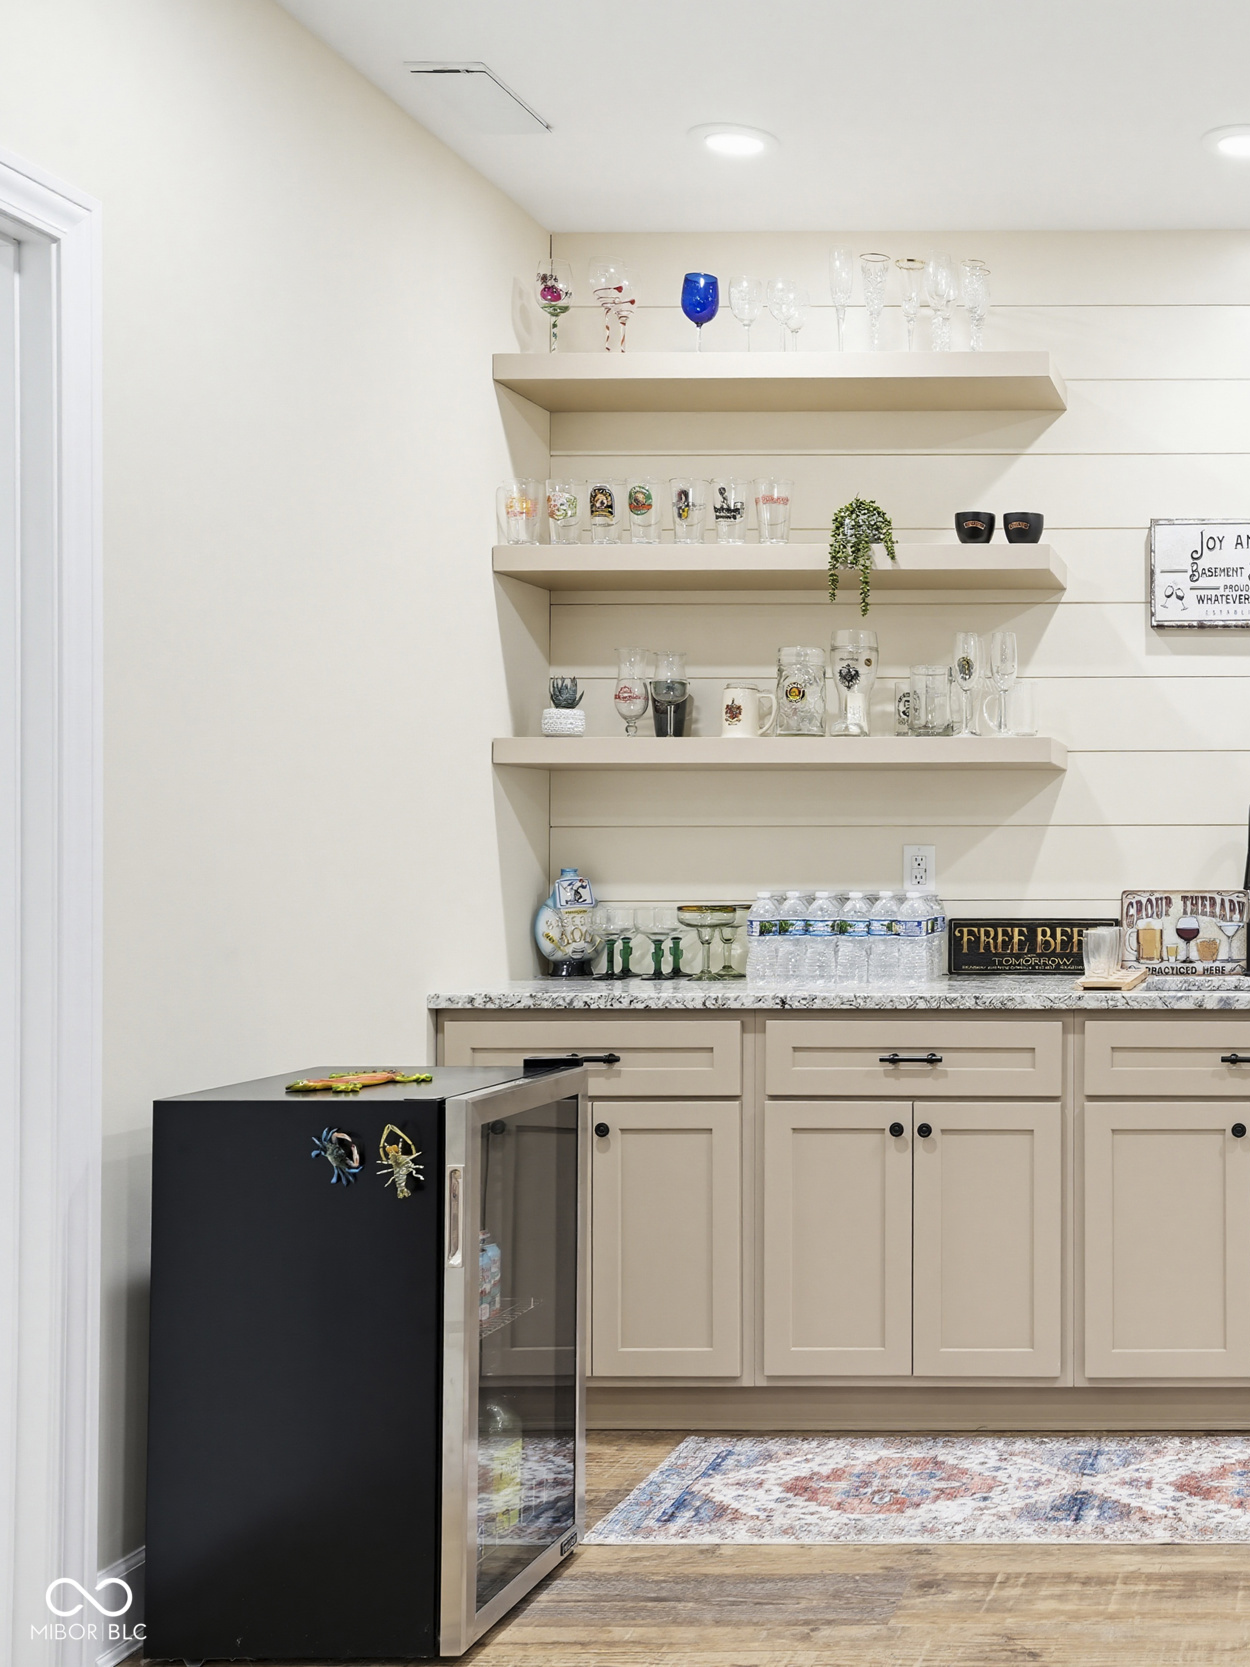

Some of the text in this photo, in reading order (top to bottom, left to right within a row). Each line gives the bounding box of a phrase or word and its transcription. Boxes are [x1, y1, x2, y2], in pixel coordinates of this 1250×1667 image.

[1196, 594, 1250, 605] WHATEVER
[1125, 895, 1245, 929] GROUP THERAPY
[955, 927, 1030, 953] FREE
[1036, 926, 1085, 953] BEE
[992, 957, 1073, 968] TOMORROW
[1202, 966, 1226, 974] HERE
